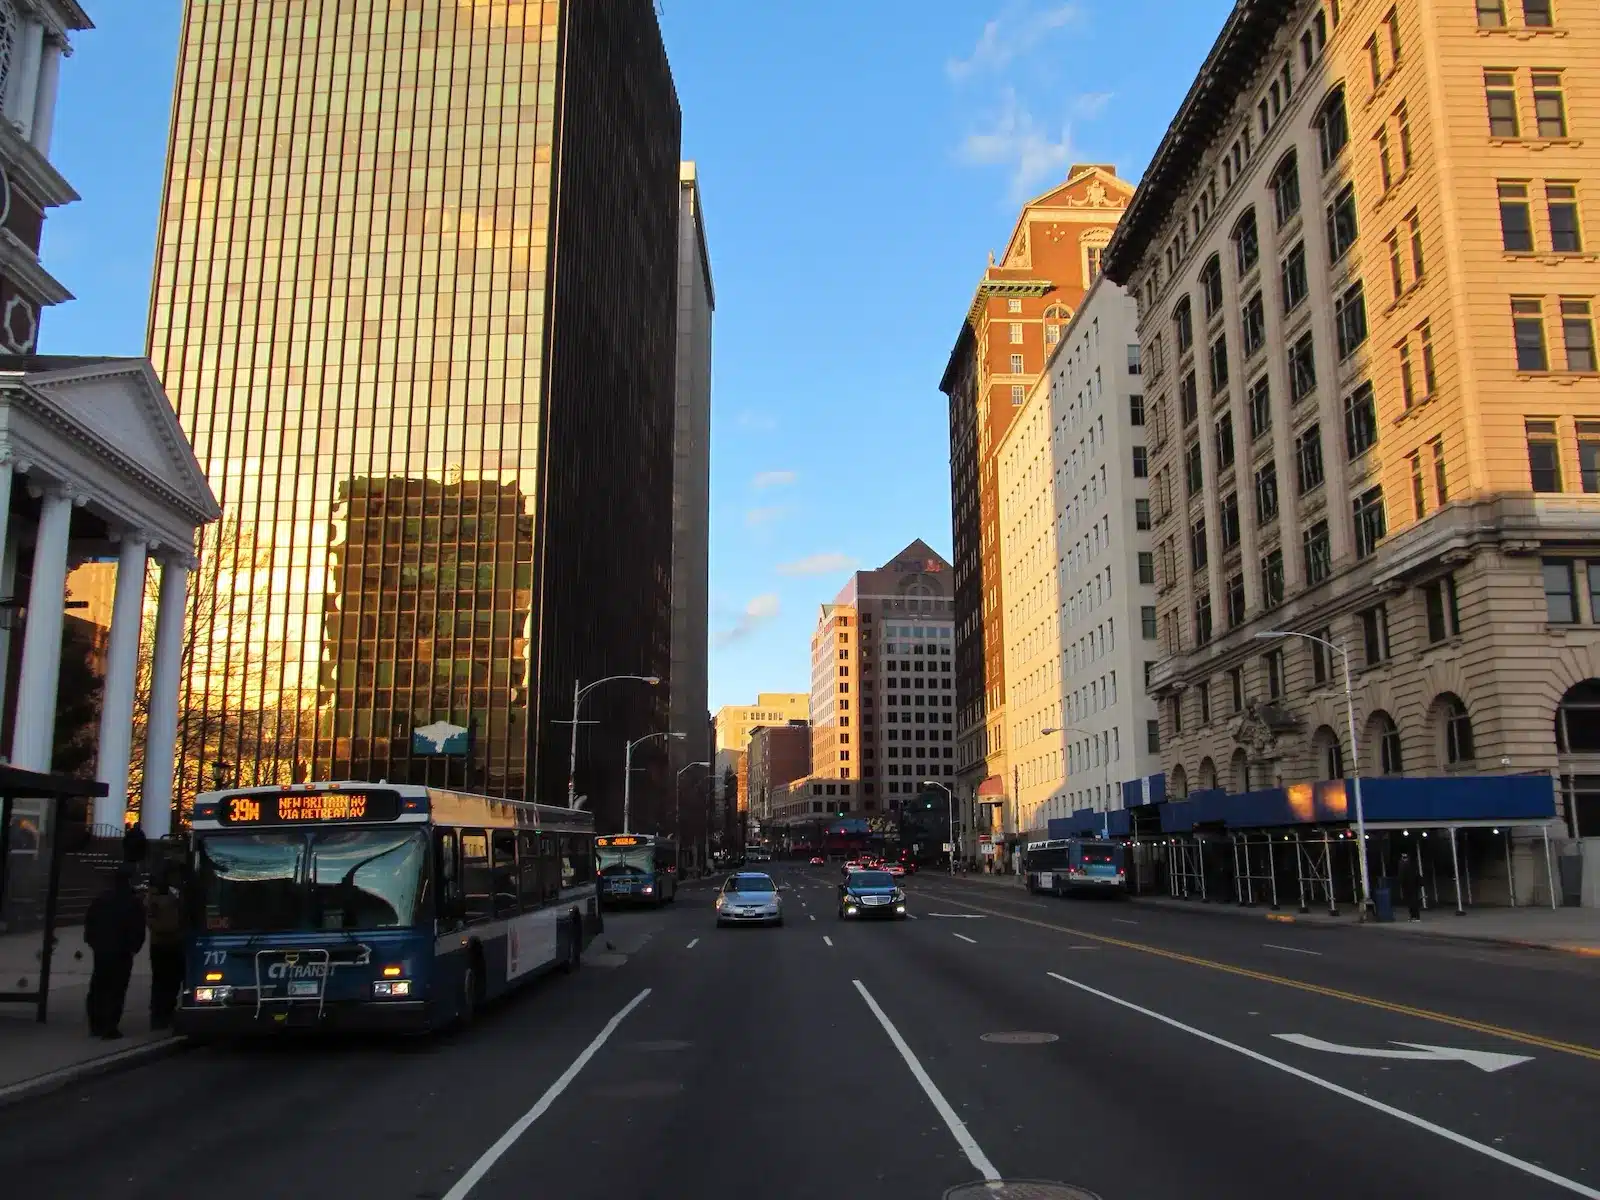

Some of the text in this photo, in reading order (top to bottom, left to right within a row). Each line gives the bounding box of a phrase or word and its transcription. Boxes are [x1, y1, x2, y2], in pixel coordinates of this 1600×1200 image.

[303, 796, 348, 808] BRITAIN
[351, 796, 366, 807] AV
[279, 807, 365, 819] VIA RETREAT AV
[204, 951, 226, 966] 717
